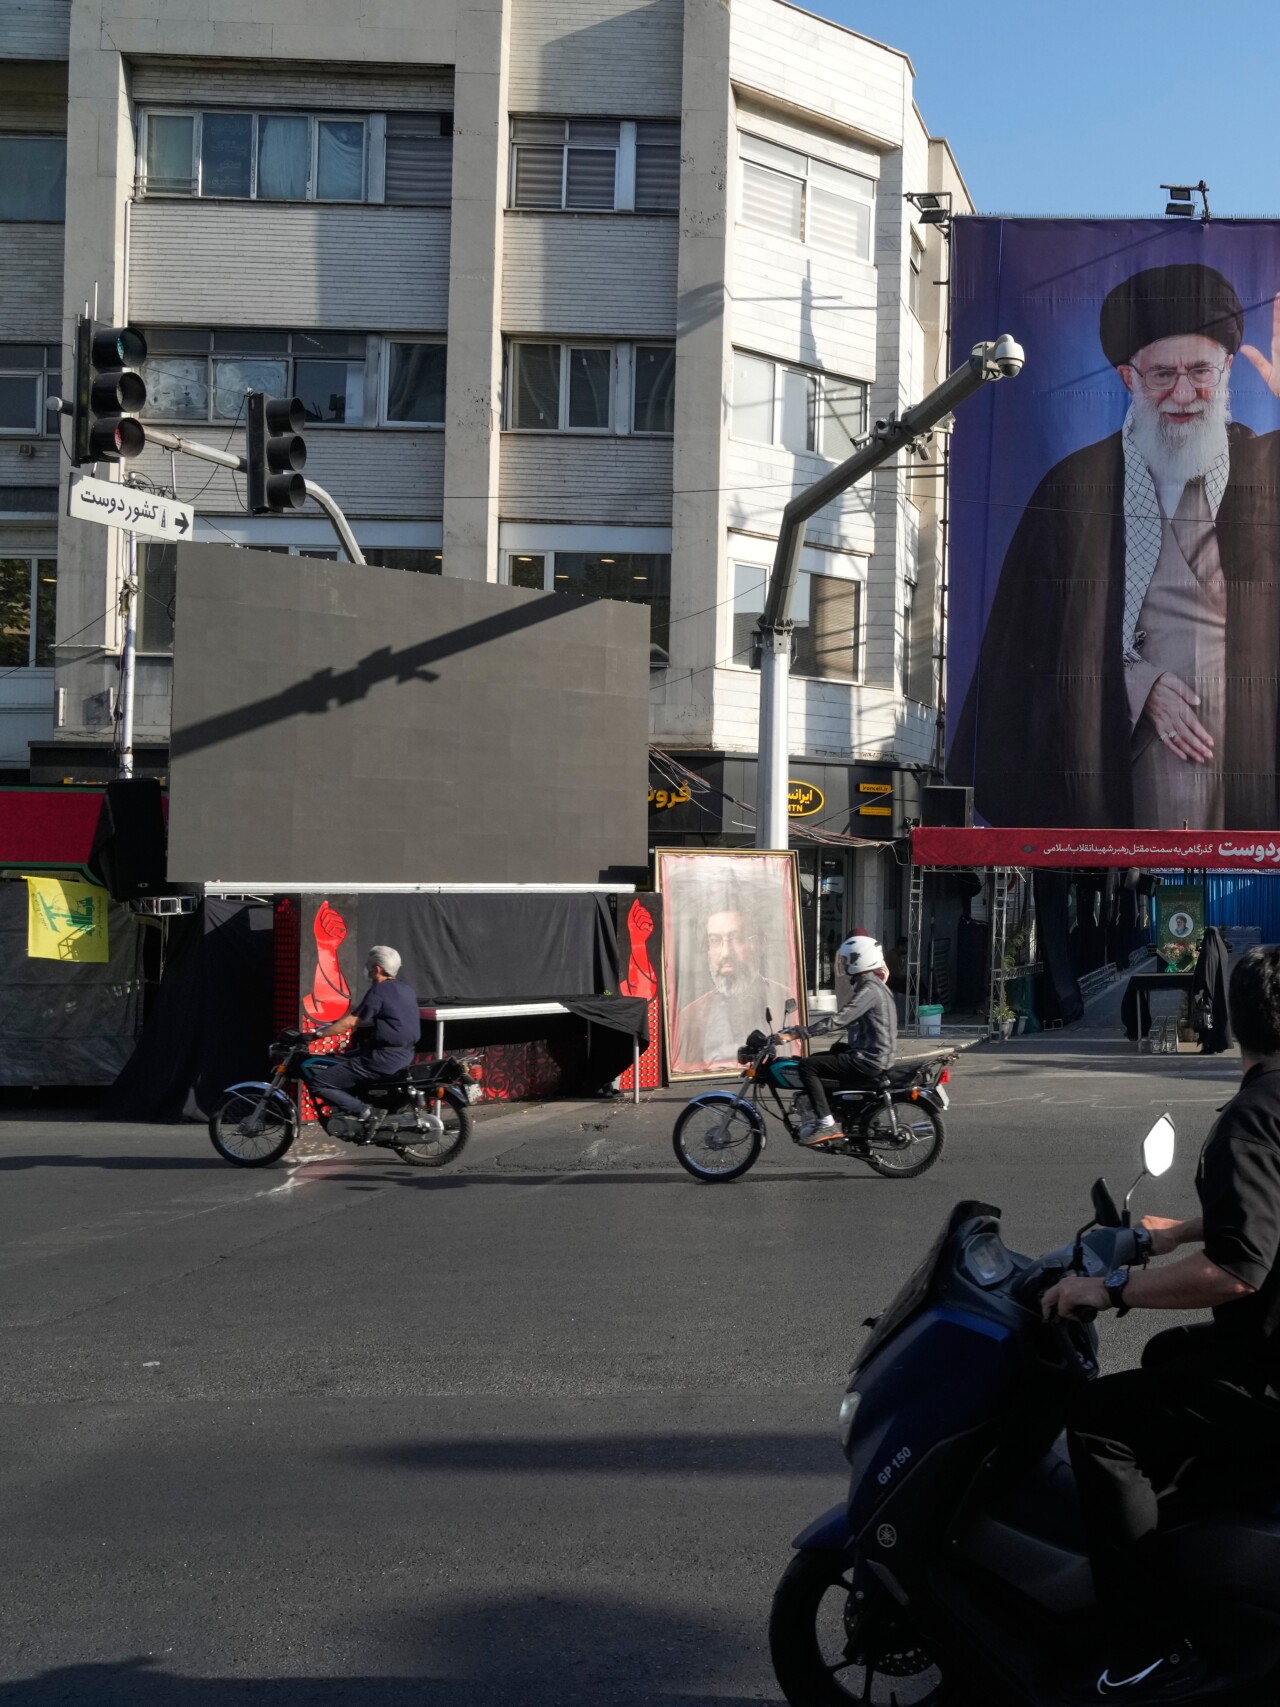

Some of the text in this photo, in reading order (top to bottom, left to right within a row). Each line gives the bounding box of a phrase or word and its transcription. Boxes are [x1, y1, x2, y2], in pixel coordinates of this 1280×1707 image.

[1044, 844, 1070, 854] اسلامی
[1070, 844, 1094, 854] انقلاب
[1094, 844, 1114, 854] شهید
[1114, 846, 1128, 855] رهبر
[1128, 844, 1149, 855] مقتل
[1173, 846, 1182, 856] به
[1181, 844, 1213, 856] گذرگاهی
[878, 1446, 912, 1484] GP 150
